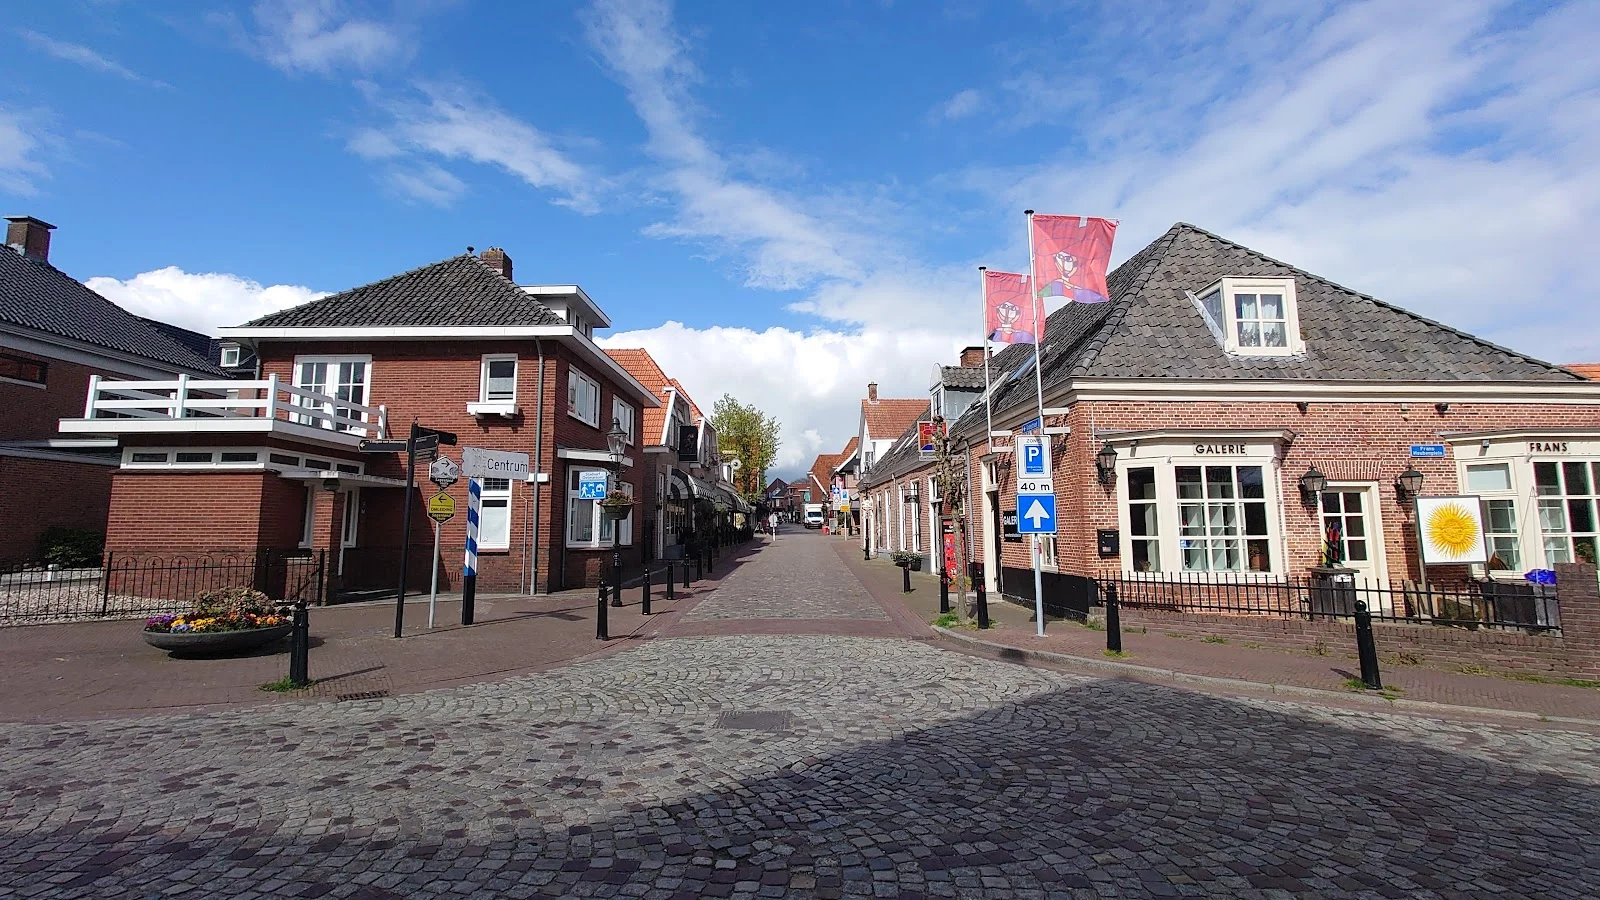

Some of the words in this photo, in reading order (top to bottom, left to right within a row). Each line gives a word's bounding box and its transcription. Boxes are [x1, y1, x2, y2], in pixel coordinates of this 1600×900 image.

[1195, 444, 1246, 454] GALERIE
[1530, 442, 1567, 452] FRANS
[1028, 447, 1040, 462] P
[487, 458, 528, 473] Centrum
[1020, 482, 1036, 491] 40
[1040, 483, 1050, 491] m
[1003, 515, 1018, 525] GALER
